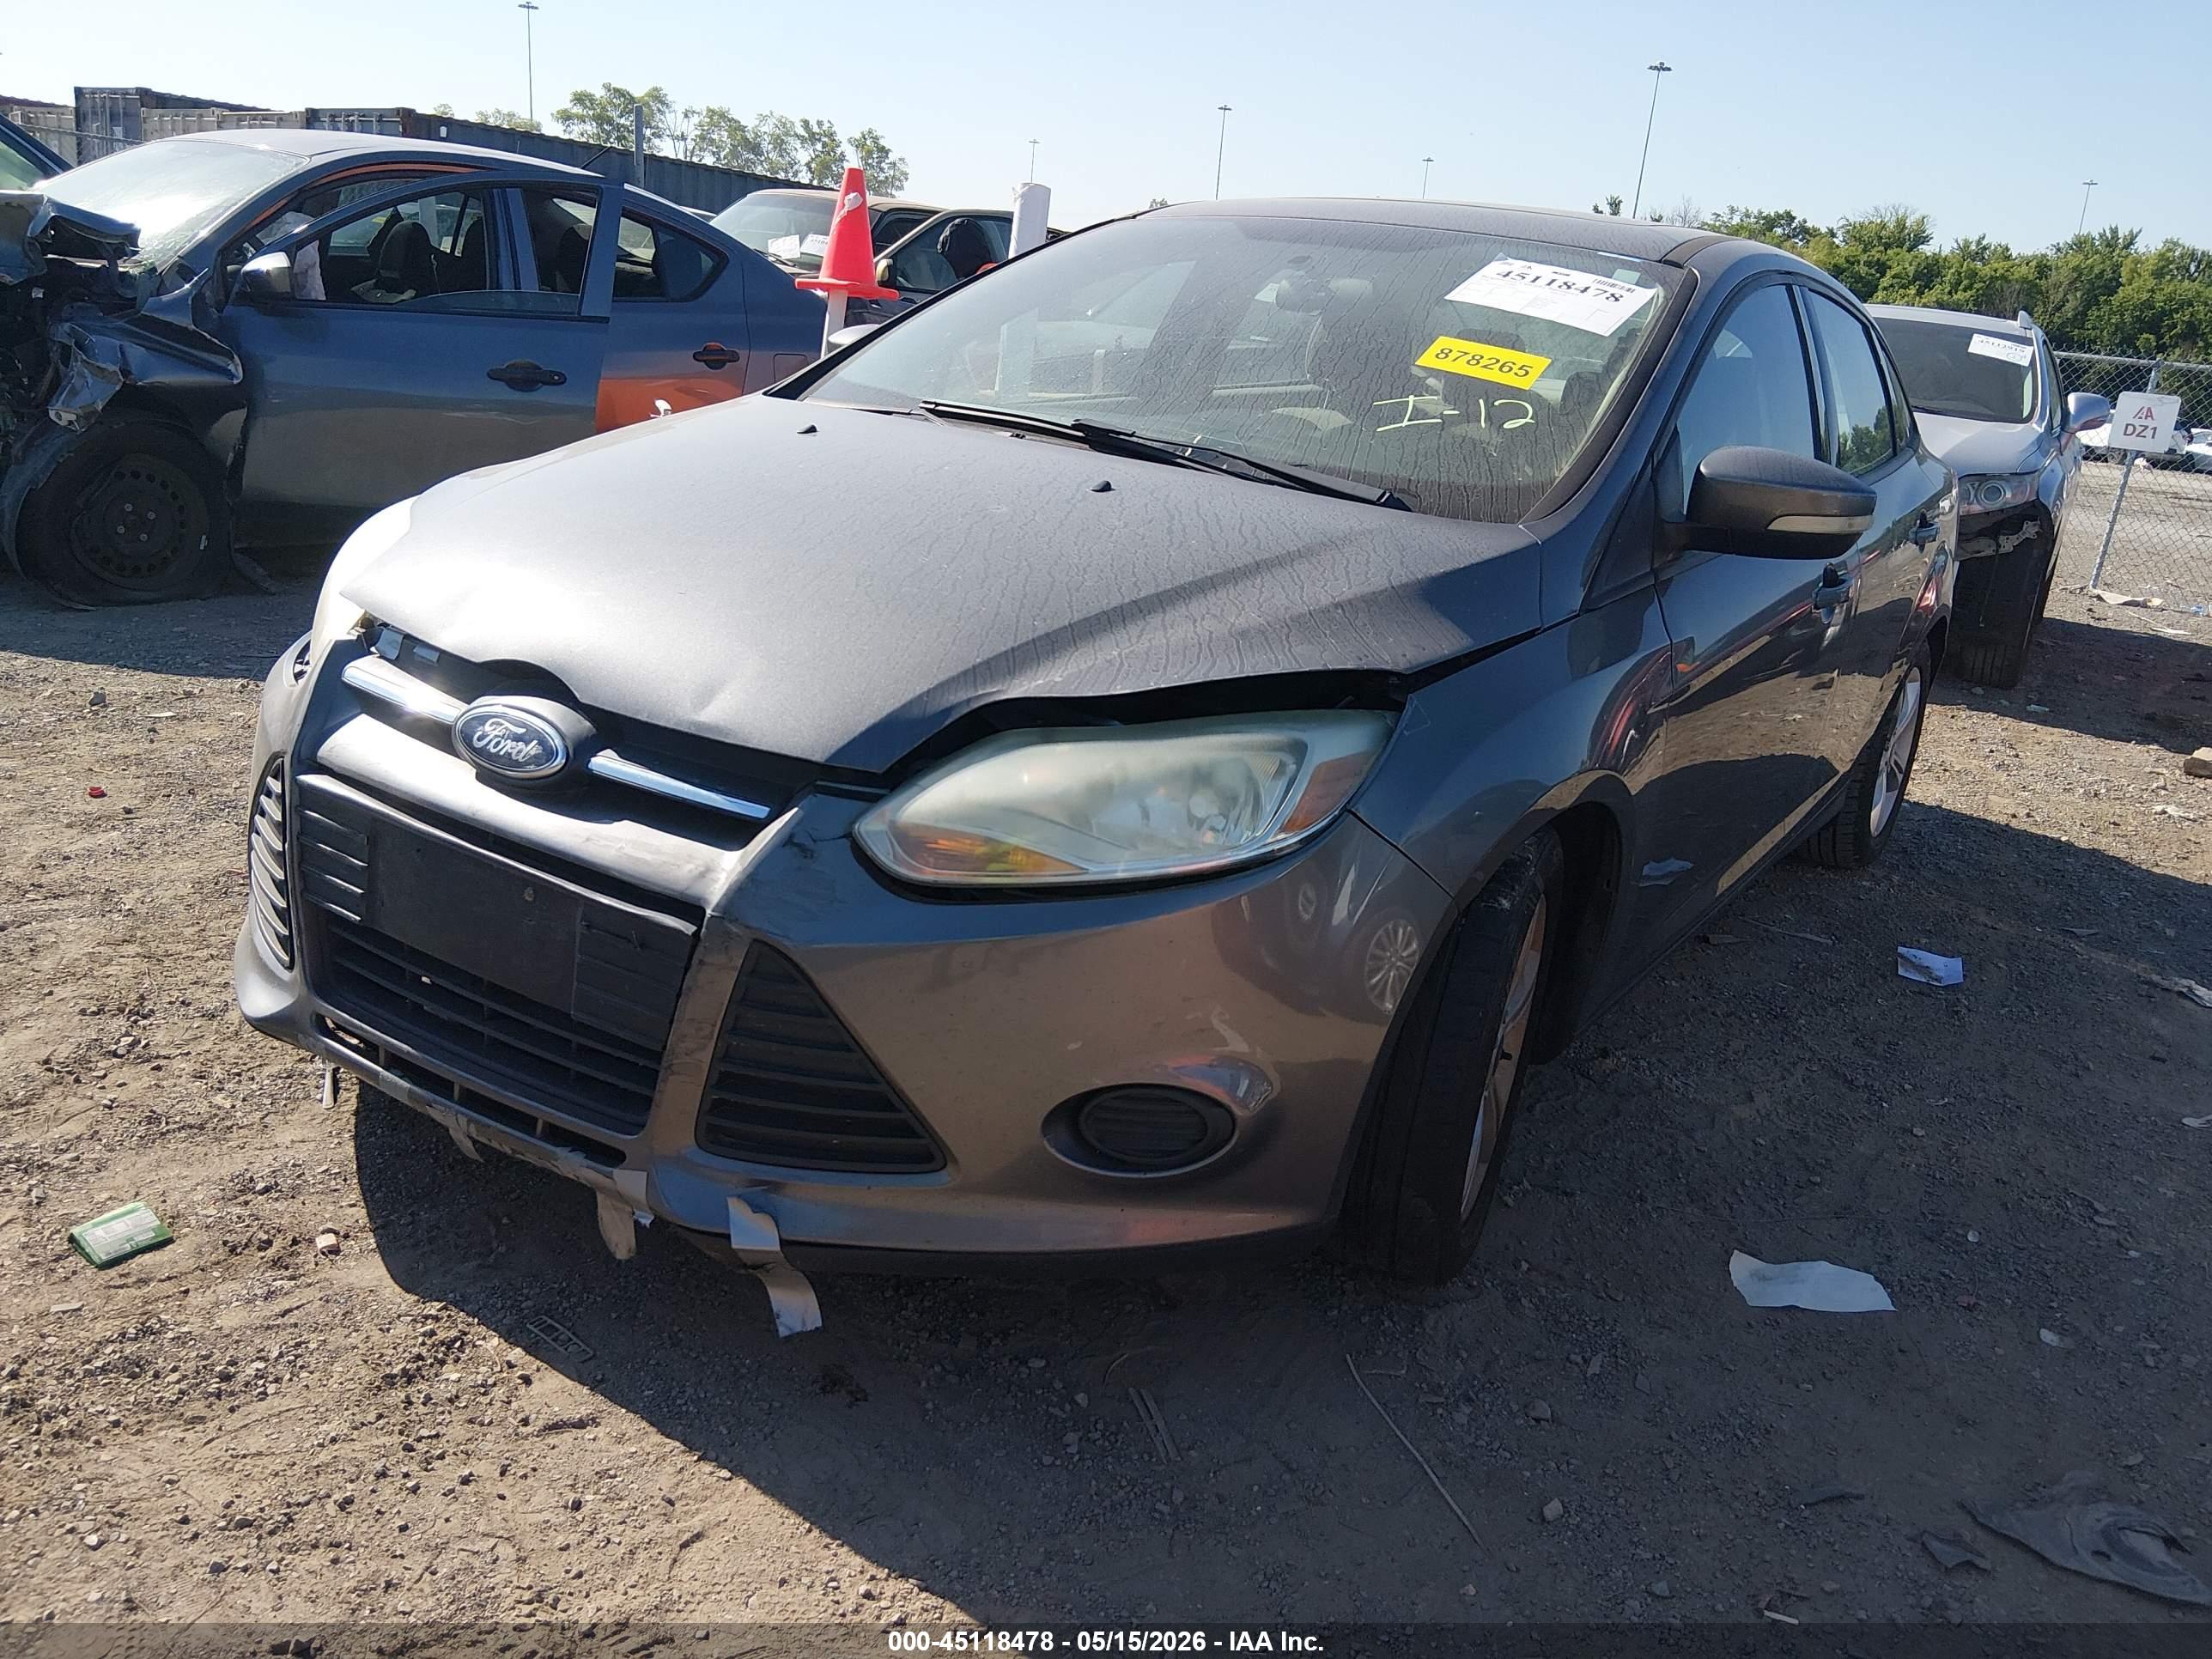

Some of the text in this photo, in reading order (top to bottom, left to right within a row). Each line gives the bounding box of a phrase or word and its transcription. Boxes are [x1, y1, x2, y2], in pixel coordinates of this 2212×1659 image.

[1497, 270, 1624, 302] 45118478
[1435, 348, 1534, 378] 878265
[2123, 423, 2158, 439] DZ1
[473, 718, 541, 762] Ford
